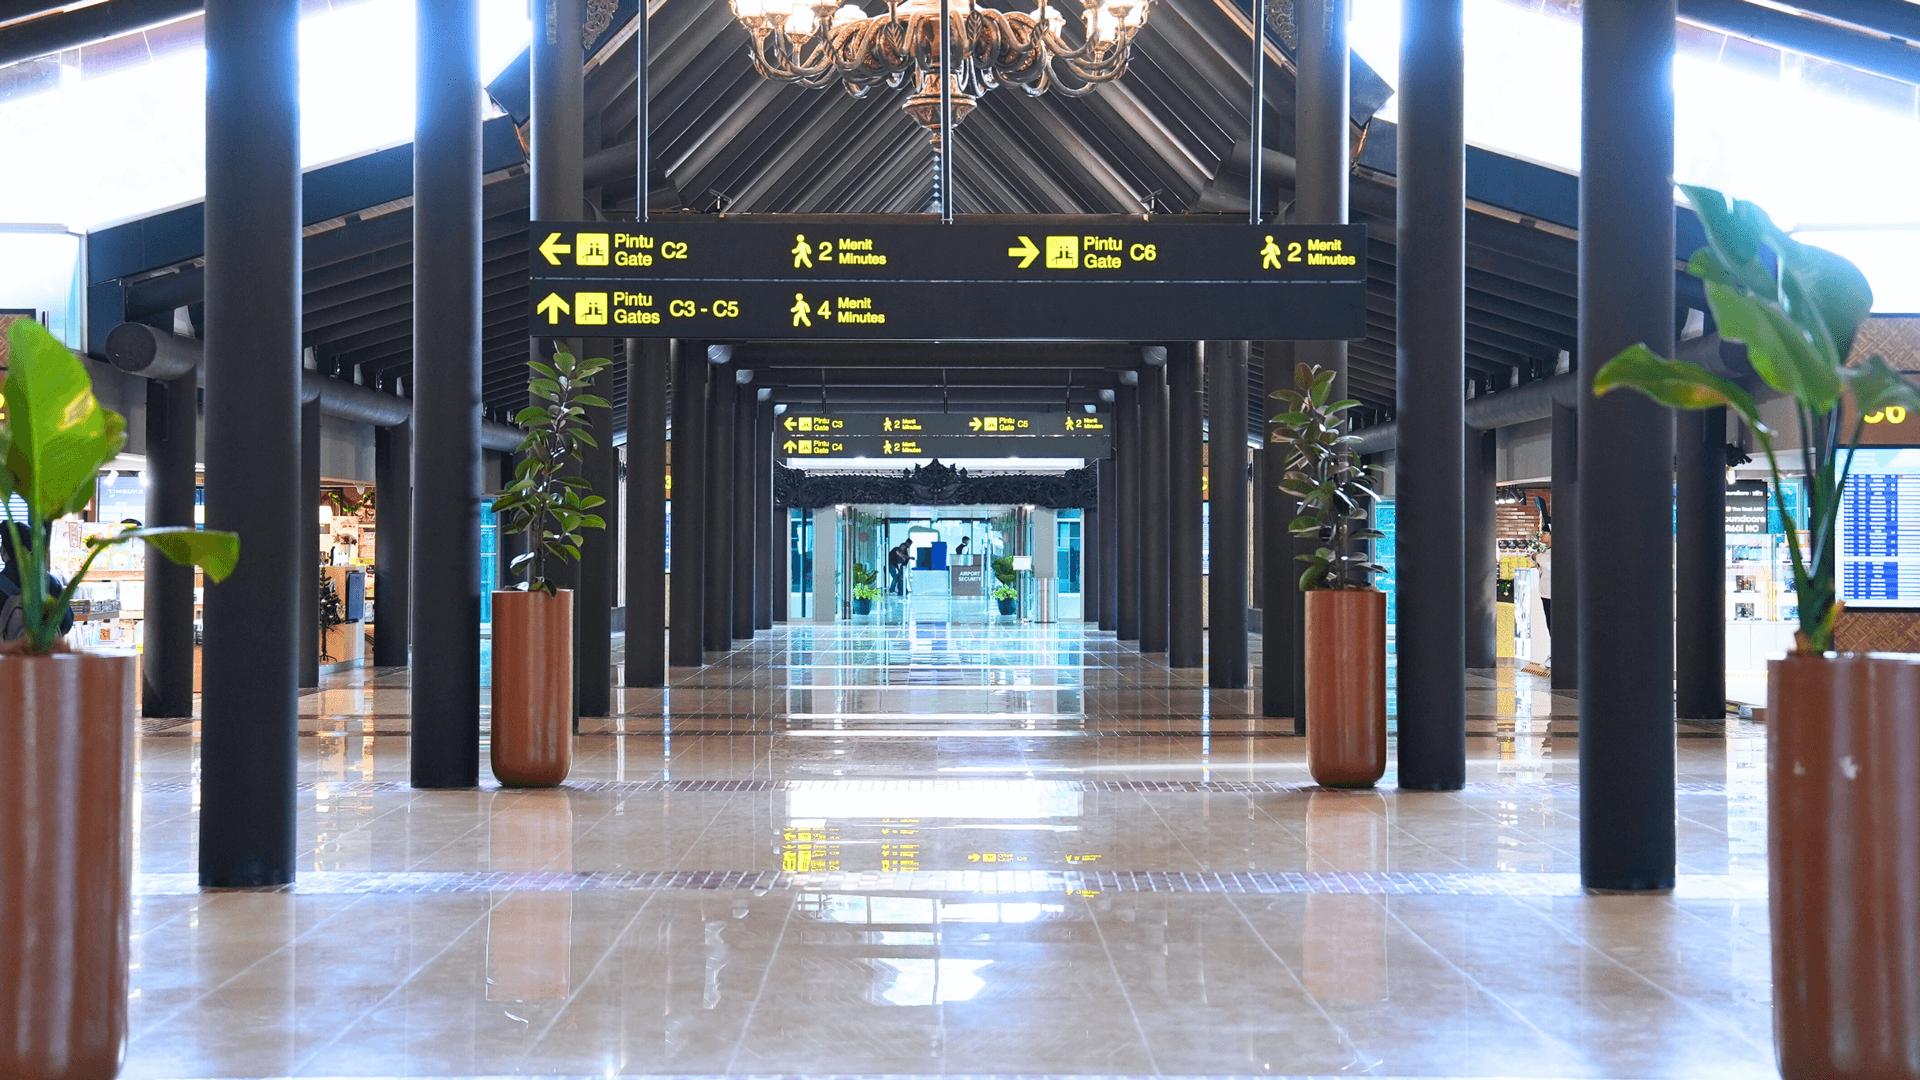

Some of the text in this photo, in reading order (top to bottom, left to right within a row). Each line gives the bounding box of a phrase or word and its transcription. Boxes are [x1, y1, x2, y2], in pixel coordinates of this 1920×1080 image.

[614, 233, 654, 249] Pintu
[1083, 236, 1123, 251] Pintu
[614, 241, 688, 266] Gate C2
[818, 239, 873, 262] 2 Menit
[1083, 243, 1157, 269] Gate C6
[1286, 239, 1342, 263] 2 Menit
[838, 252, 887, 265] Minutes
[1307, 252, 1357, 265] Minutes
[613, 292, 653, 306] Pintu
[613, 308, 661, 324] Gates
[669, 300, 696, 318] C3
[712, 300, 740, 318] C5
[817, 297, 872, 320] 4 Menit
[837, 311, 886, 324] Minutes
[814, 420, 844, 432] Gate C3
[894, 420, 901, 429] 2
[1017, 420, 1029, 428] C5
[1075, 419, 1083, 428] 2
[831, 443, 843, 451] C4
[894, 443, 901, 452] 2
[1745, 524, 1759, 532] NC
